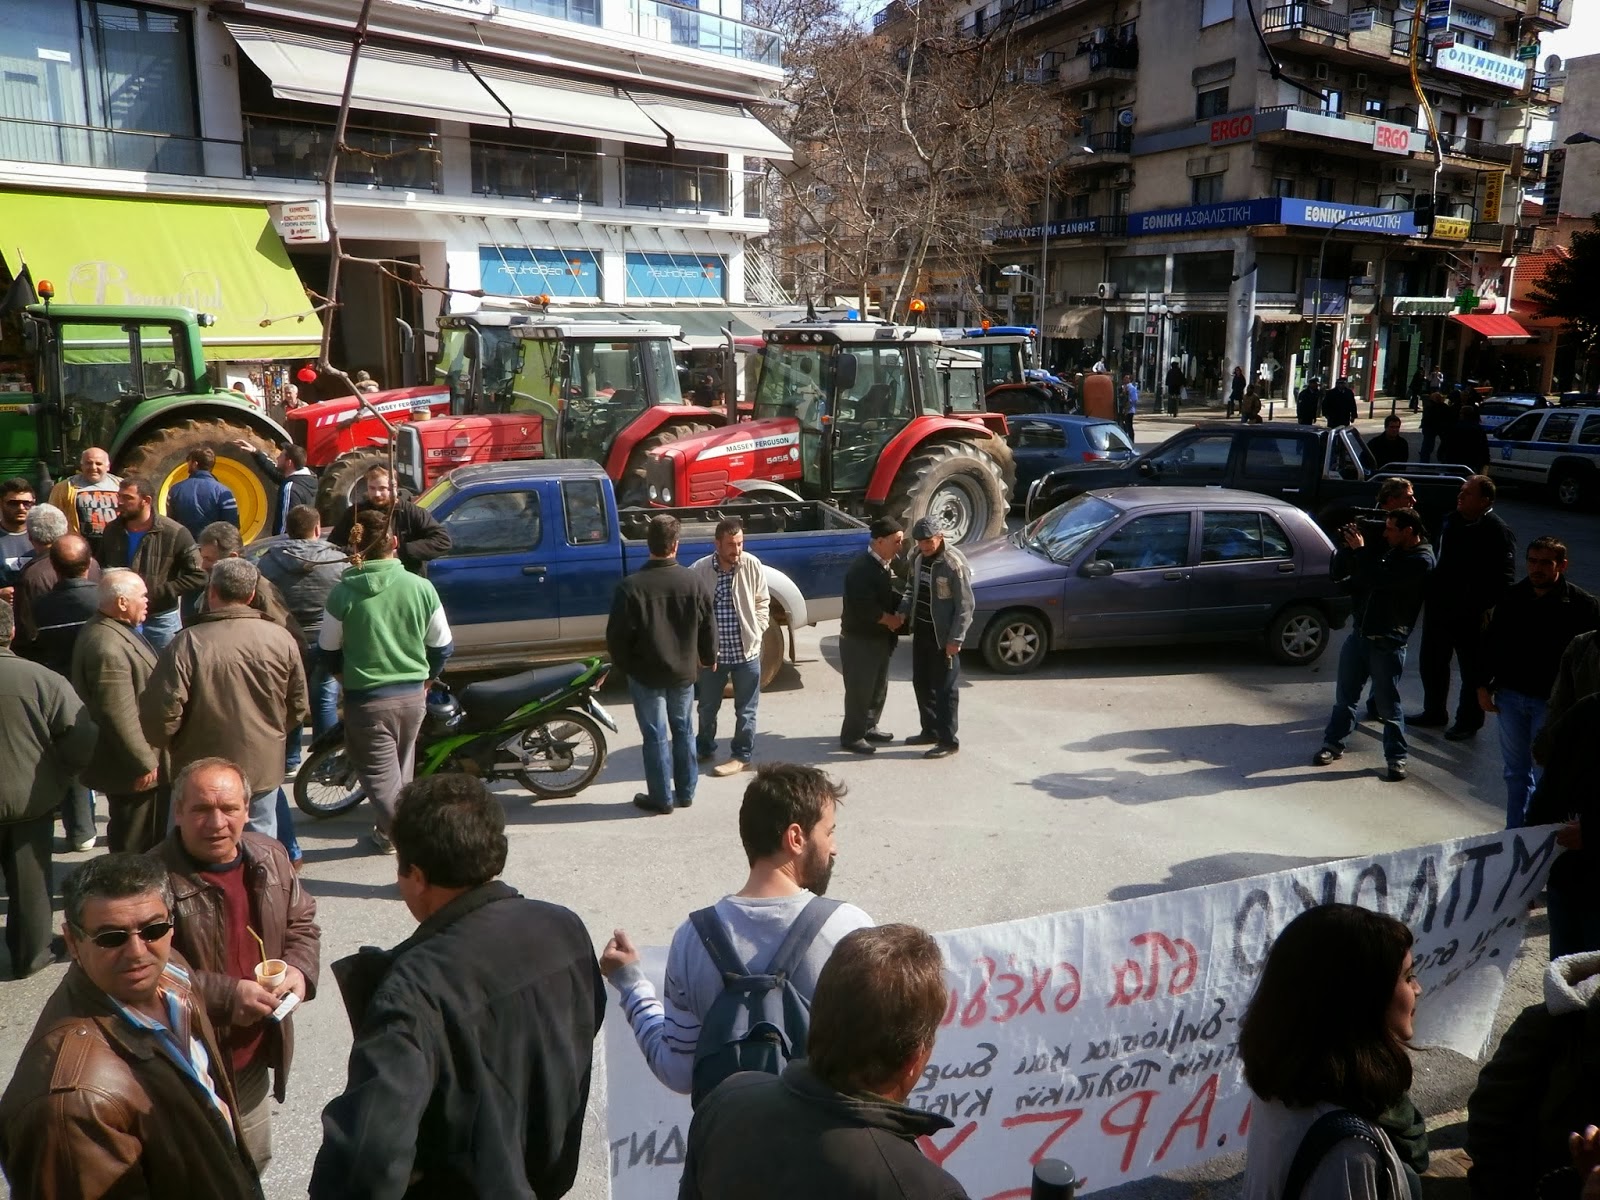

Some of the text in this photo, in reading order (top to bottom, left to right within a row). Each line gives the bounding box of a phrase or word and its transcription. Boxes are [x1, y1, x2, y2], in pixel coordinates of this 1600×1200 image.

[1448, 48, 1525, 80] ΟΛΥΜΠΙΑΚΗ
[1210, 114, 1253, 142] ERGO
[1376, 126, 1409, 150] ERGO
[1060, 221, 1096, 235] ΞΑΝΘΗΣ
[1142, 205, 1251, 230] ΕΘΝΙΚΗ ΑΣΦΑΛΙΣΤΙΚΗ
[1305, 205, 1401, 230] ΕΘΝΙΚΗ ΑΣΦΑΛΙΣΤΙΚΗ
[398, 399, 431, 409] FERGUSON
[726, 437, 790, 452] MASSEY FERGUSON
[766, 455, 789, 464] 5455
